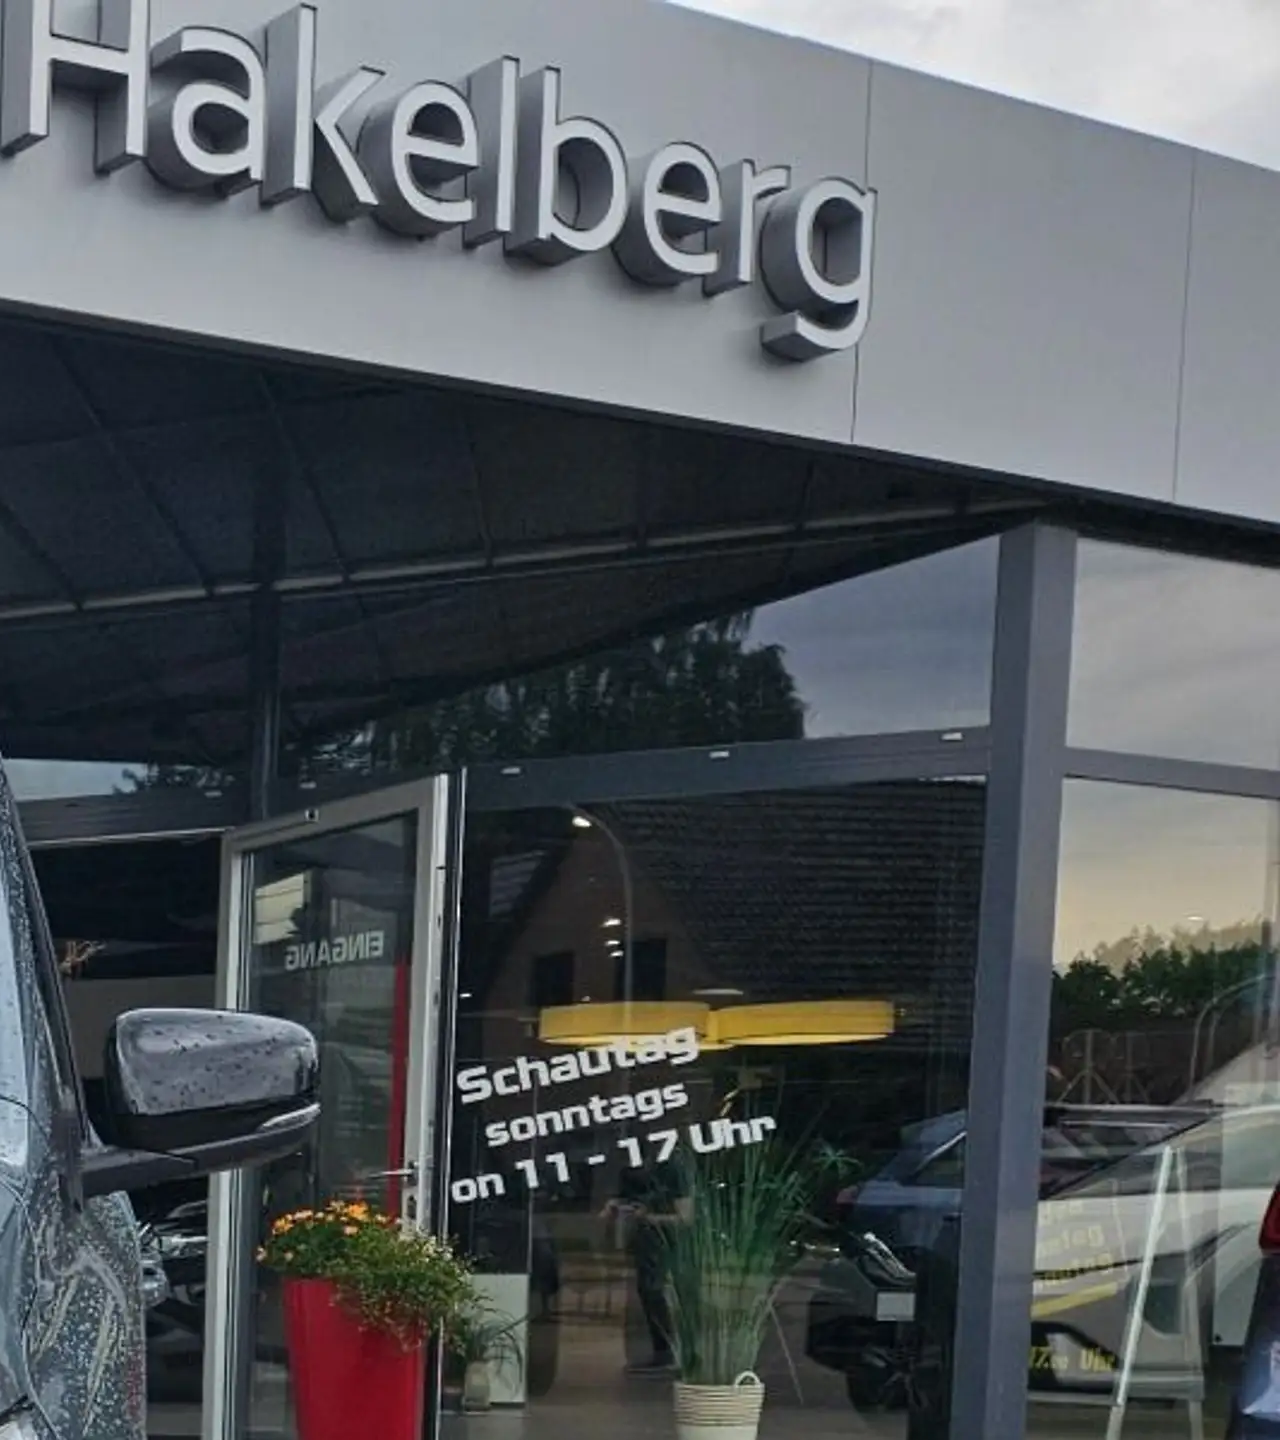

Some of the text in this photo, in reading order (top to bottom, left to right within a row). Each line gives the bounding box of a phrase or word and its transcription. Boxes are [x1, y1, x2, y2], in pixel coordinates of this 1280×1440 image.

[18, 0, 877, 352] Hakelberg
[456, 1026, 700, 1103] Schautag
[485, 1083, 688, 1147] sonntags
[451, 1172, 506, 1204] on
[689, 1115, 777, 1154] Uhr
